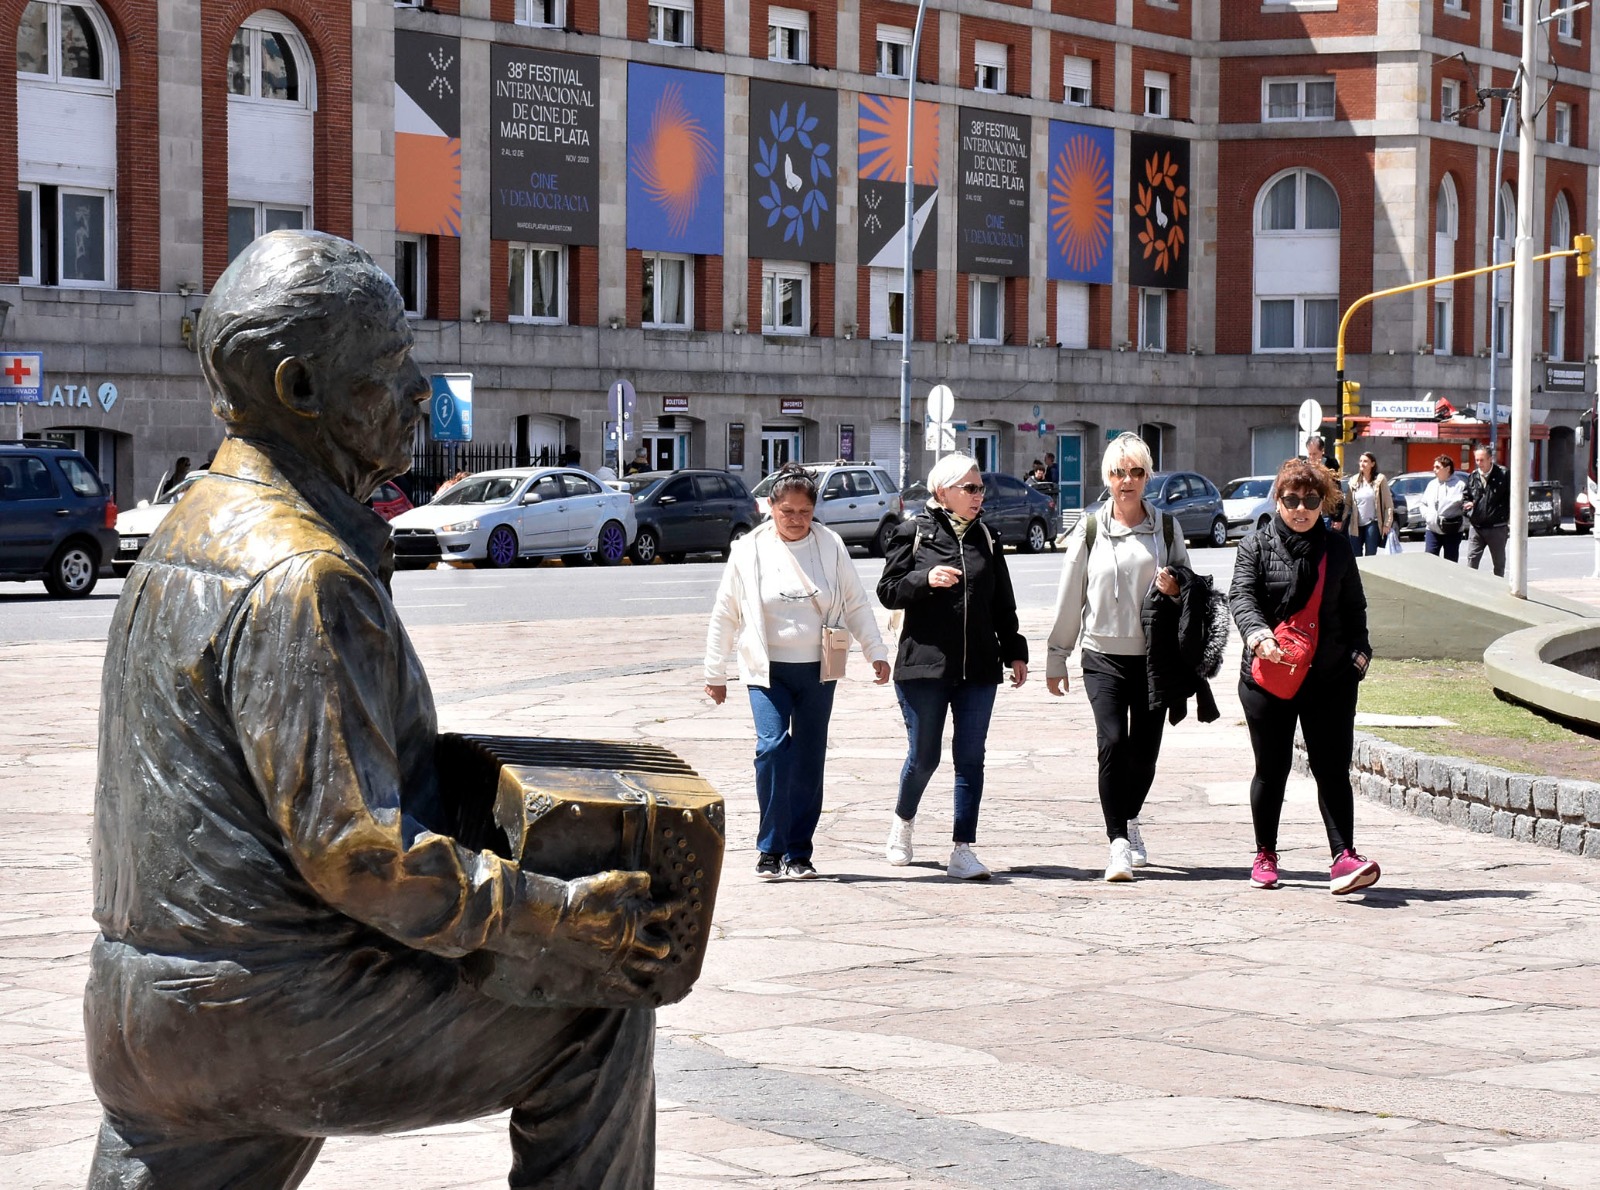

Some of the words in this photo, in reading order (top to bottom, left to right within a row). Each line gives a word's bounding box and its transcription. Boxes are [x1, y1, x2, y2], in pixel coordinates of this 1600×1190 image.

[529, 64, 583, 86] FESTIVAL
[496, 80, 594, 107] INTERNACIONAL
[513, 103, 529, 120] DE
[531, 105, 560, 124] CINE
[562, 108, 578, 126] DE
[500, 121, 527, 139] MAR
[529, 125, 552, 142] DEL
[554, 128, 590, 146] PLATA
[985, 122, 1021, 141] FESTIVAL
[963, 136, 1028, 158] INTERNACIONAL
[566, 155, 576, 163] NOV
[974, 155, 986, 170] DE
[986, 156, 1005, 173] CINE
[1006, 159, 1018, 174] DE
[530, 172, 558, 190] CINE
[965, 171, 985, 186] MAR
[985, 173, 1001, 188] DEL
[1002, 175, 1025, 192] PLATA
[500, 189, 508, 205] Y
[510, 190, 590, 212] DEMOCRACIA
[985, 213, 1005, 229] CINE
[24, 384, 92, 407] ATA
